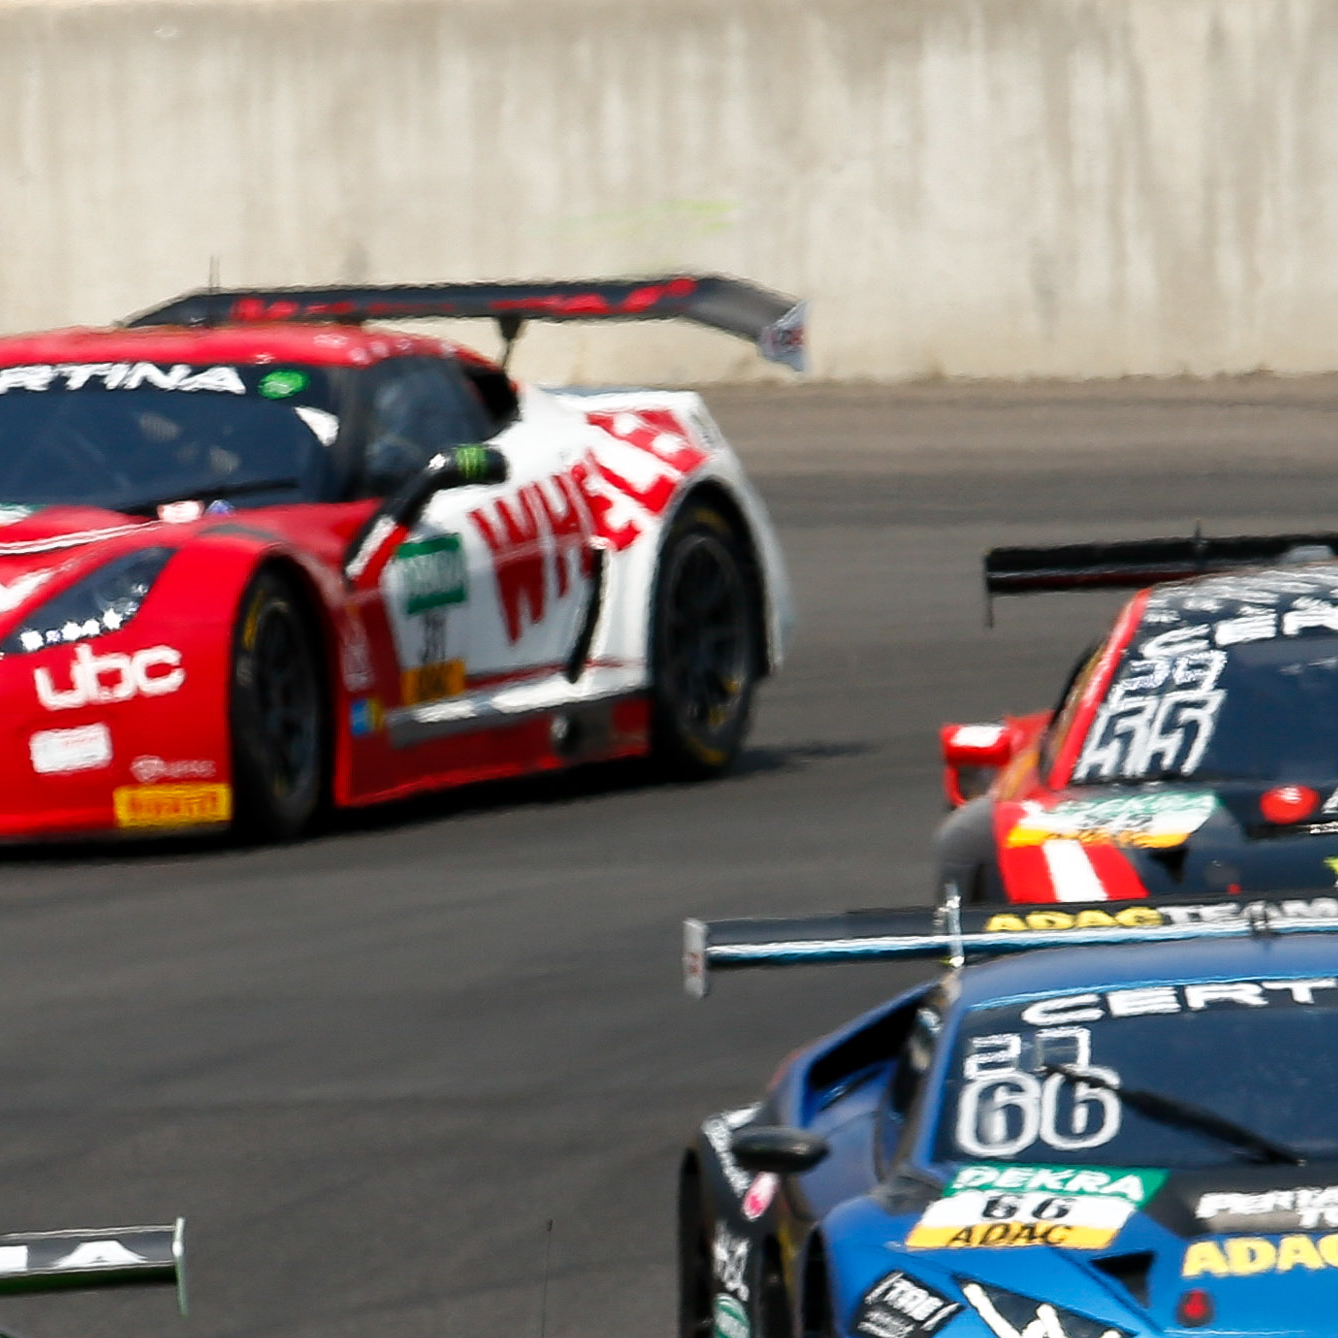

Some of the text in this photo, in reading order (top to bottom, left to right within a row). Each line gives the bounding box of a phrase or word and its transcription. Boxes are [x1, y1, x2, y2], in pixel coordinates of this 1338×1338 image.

[33, 643, 187, 712] ubc
[956, 1067, 1123, 1157] 66
[952, 1165, 1145, 1202] DEKRA
[947, 1222, 1074, 1247] ADAC
